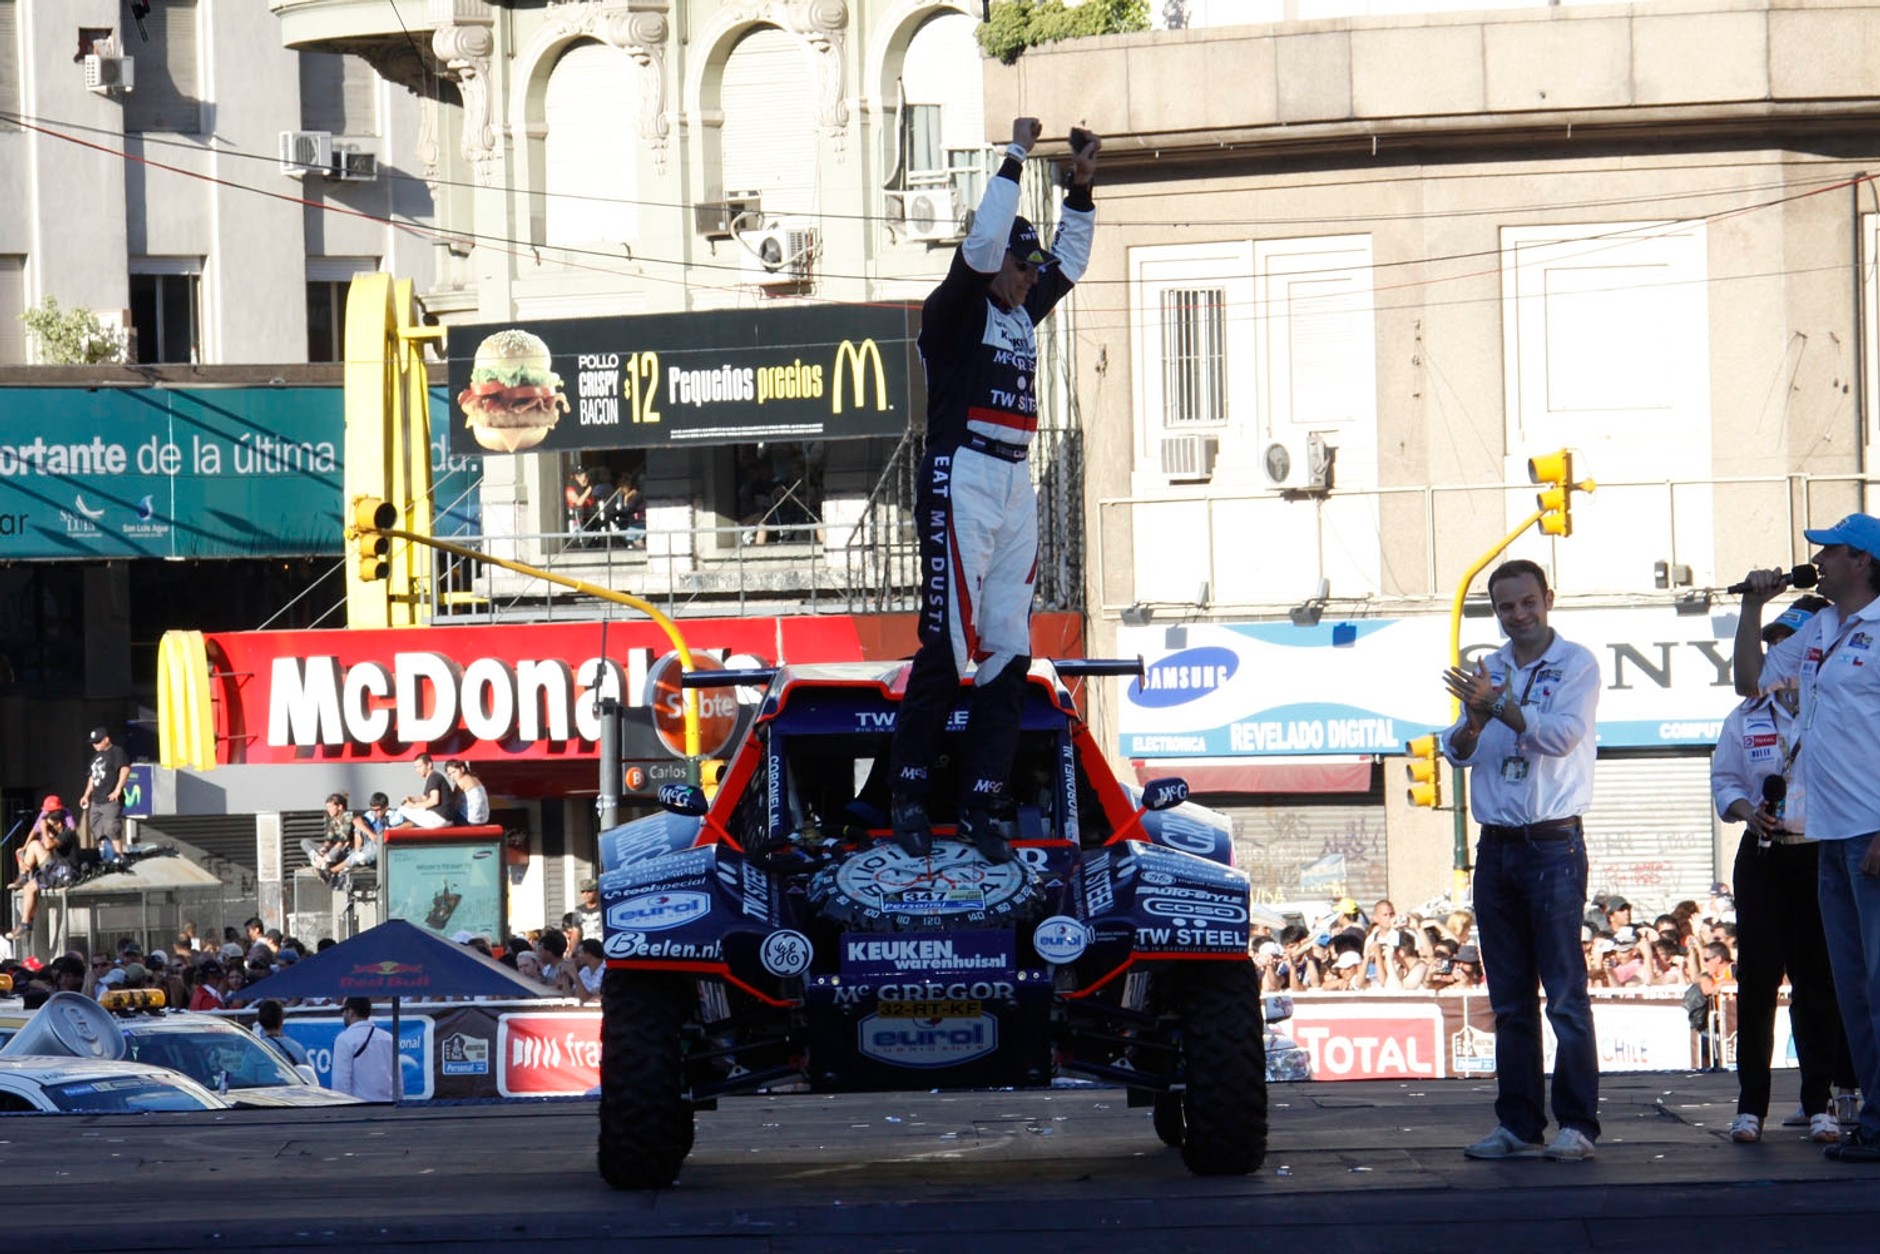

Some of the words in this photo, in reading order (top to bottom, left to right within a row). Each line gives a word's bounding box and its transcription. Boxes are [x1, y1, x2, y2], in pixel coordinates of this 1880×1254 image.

[578, 353, 619, 369] POLLO
[578, 370, 619, 399] CRISPY
[669, 366, 755, 408] Pequeños
[757, 359, 824, 405] precios
[990, 389, 1016, 406] TW
[579, 398, 619, 426] BACON
[137, 436, 182, 475] de
[193, 436, 222, 475] la
[233, 432, 336, 475] última
[932, 455, 951, 498] EAT
[929, 510, 947, 545] MY
[928, 557, 946, 633] DUST!
[1142, 664, 1228, 690] SAMSUNG
[665, 691, 734, 719] Sbte
[854, 711, 897, 727] TW
[1230, 721, 1324, 752] REVELADO
[1328, 717, 1399, 749] DIGITAL
[632, 774, 642, 786] B
[650, 765, 687, 780] Carlos
[1157, 783, 1188, 802] McG
[883, 901, 947, 910] Personal
[903, 891, 947, 902] 347
[618, 900, 700, 922] eurol
[923, 913, 942, 926] 120
[967, 911, 986, 921] 140
[1154, 902, 1236, 917] COSO
[613, 932, 721, 959] Beelen.nl
[1039, 934, 1082, 947] eurol
[1135, 928, 1171, 945] TW
[1176, 928, 1247, 946] STEEL
[848, 940, 953, 961] KEUKEN
[872, 1023, 984, 1047] eurol
[1297, 1027, 1433, 1074] TOTAL
[1601, 1037, 1649, 1064] CHILE
